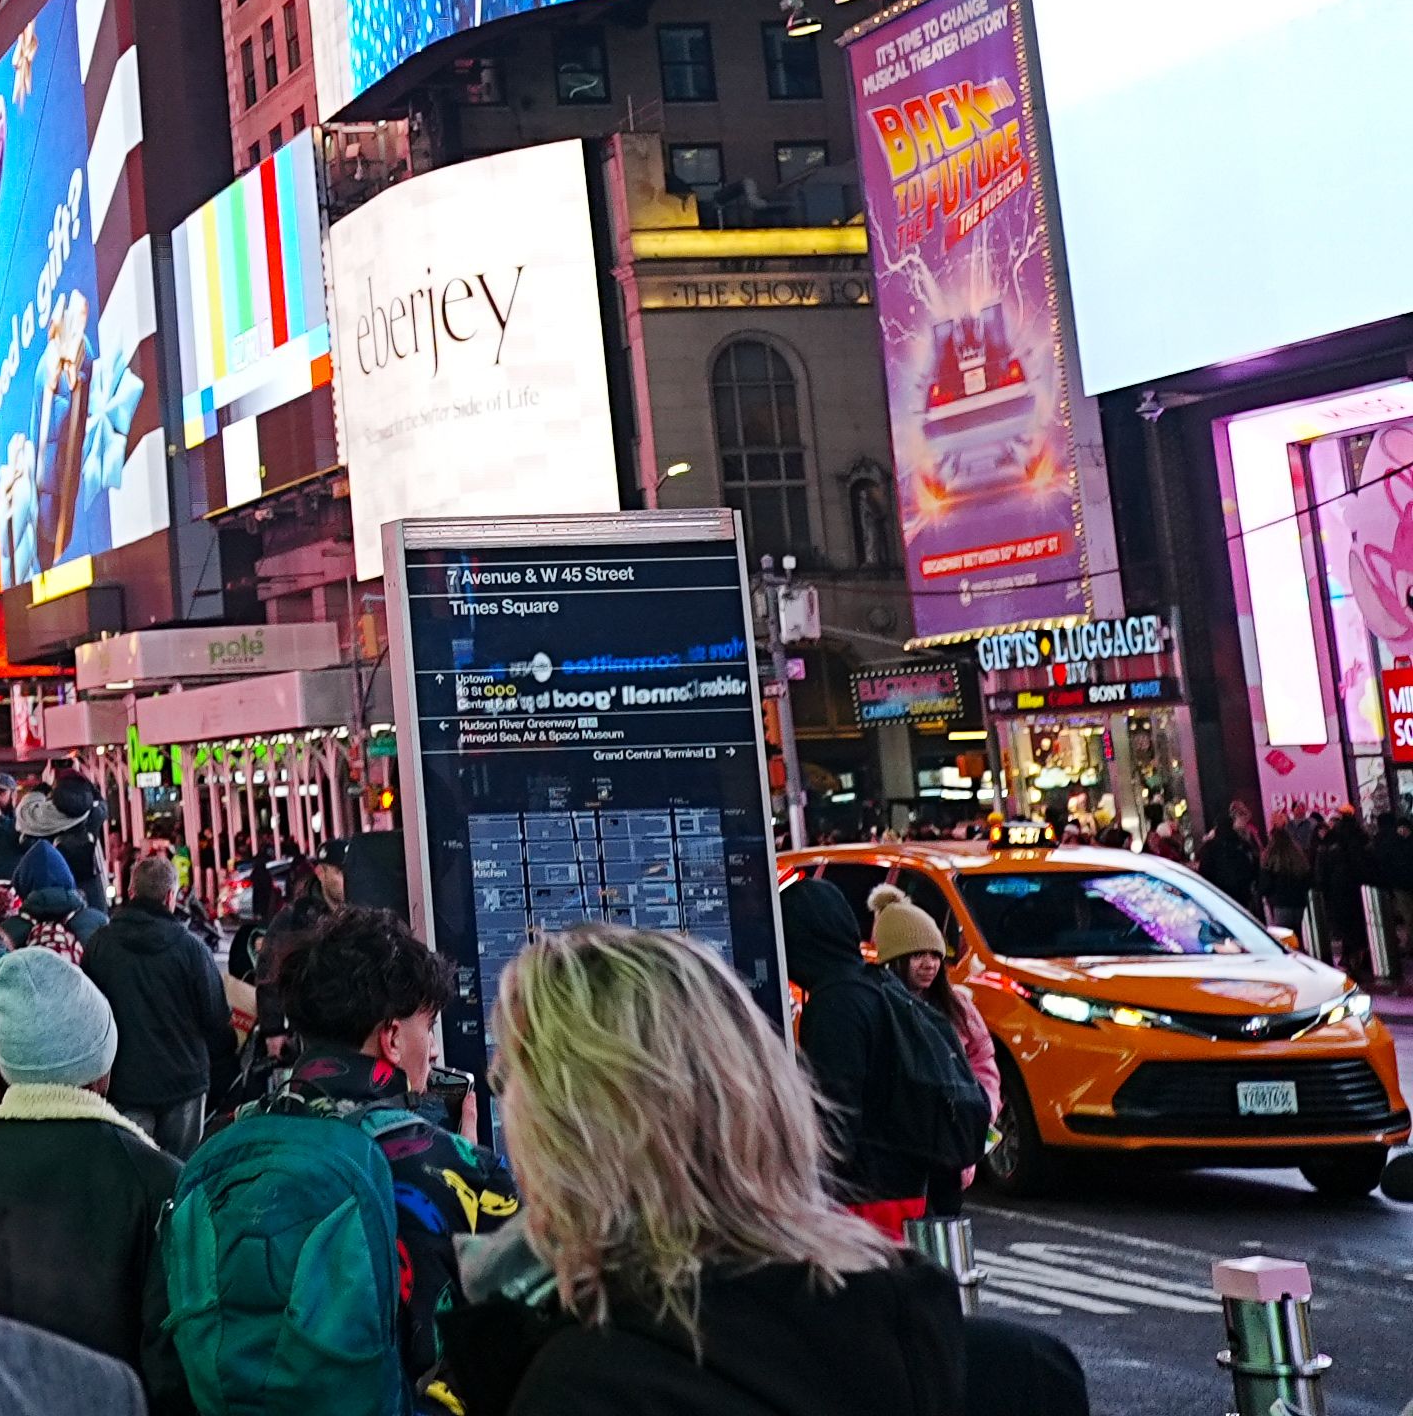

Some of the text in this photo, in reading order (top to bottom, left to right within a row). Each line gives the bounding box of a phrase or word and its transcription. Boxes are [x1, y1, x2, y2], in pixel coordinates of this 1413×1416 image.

[863, 5, 1009, 97] MUSICAL THEATER HISTORY
[898, 30, 923, 59] TIME
[924, 21, 940, 47] TO
[867, 80, 994, 181] BACK
[922, 118, 1022, 233] FUTURE
[893, 178, 923, 221] TO
[958, 167, 1024, 236] THE MUSICAL
[37, 167, 83, 329] gift?
[897, 215, 925, 254] THE
[676, 281, 815, 305] THE SHOW
[21, 300, 35, 349] a
[357, 265, 526, 378] eberjey
[487, 392, 501, 412] of
[507, 385, 540, 410] Life
[447, 566, 634, 585] 7 Avenue & W 45 Street
[449, 599, 559, 617] Times Square
[978, 615, 1161, 671] GIFTS LUGGAGE
[455, 674, 493, 685] Uptown
[1089, 684, 1126, 702] SONY
[459, 718, 576, 732] Hudson River Greenway
[459, 729, 624, 744] Intrepid Sea, Air & Space Museum
[593, 748, 704, 762] Grand Central Terminal
